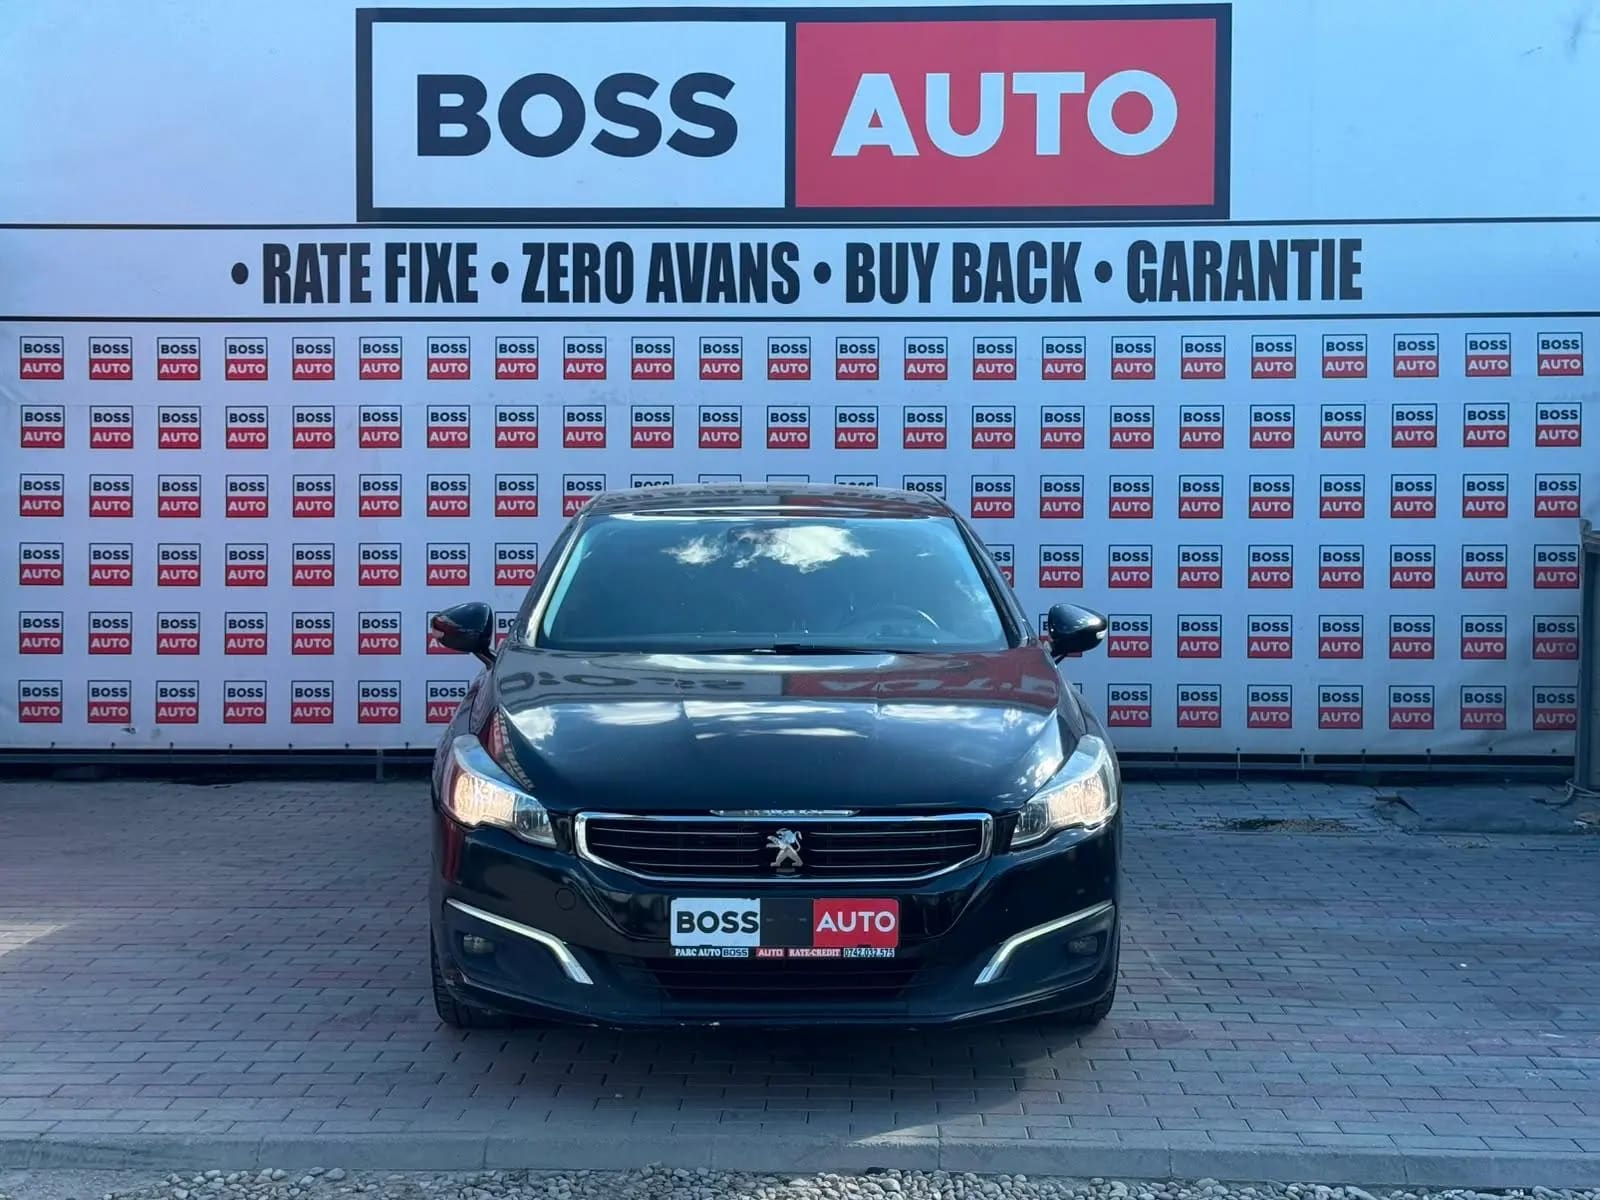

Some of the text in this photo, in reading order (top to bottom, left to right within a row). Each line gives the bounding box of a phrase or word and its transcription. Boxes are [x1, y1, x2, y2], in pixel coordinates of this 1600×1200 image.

[417, 70, 1177, 157] BOSS AUTO
[263, 239, 1362, 304] RATE FIXE ZERO AVANS BUY BACK GARANTIE
[23, 343, 61, 354] BOSS
[160, 344, 197, 355] BOSS
[295, 343, 332, 355] BOSS
[362, 343, 399, 354] BOSS
[498, 343, 536, 354] BOSS
[634, 343, 672, 354] BOSS
[703, 343, 740, 354] BOSS
[839, 343, 876, 354] BOSS
[976, 343, 1014, 354] BOSS
[1045, 343, 1083, 354] BOSS
[1184, 342, 1223, 353] BOSS
[1325, 341, 1364, 352] BOSS
[1397, 340, 1436, 352] BOSS
[1540, 339, 1580, 350] BOSS
[22, 362, 62, 373] AUTO
[159, 363, 199, 374] AUTO
[294, 363, 333, 374] AUTO
[361, 362, 401, 373] AUTO
[497, 362, 537, 373] AUTO
[633, 362, 673, 374] AUTO
[701, 363, 741, 374] AUTO
[838, 363, 877, 374] AUTO
[975, 363, 1015, 374] AUTO
[1044, 362, 1084, 374] AUTO
[1183, 362, 1224, 373] AUTO
[1324, 360, 1365, 372] AUTO
[1395, 360, 1437, 371] AUTO
[1540, 358, 1582, 370] AUTO
[24, 411, 62, 423] BOSS
[161, 412, 198, 424] BOSS
[229, 412, 265, 424] BOSS
[362, 411, 399, 423] BOSS
[498, 411, 535, 423] BOSS
[566, 411, 603, 423] BOSS
[702, 412, 739, 423] BOSS
[838, 412, 876, 424] BOSS
[906, 412, 944, 423] BOSS
[1044, 412, 1082, 423] BOSS
[1183, 411, 1221, 423] BOSS
[1253, 411, 1292, 423] BOSS
[1395, 410, 1434, 422] BOSS
[1539, 409, 1579, 421] BOSS
[22, 431, 63, 442] AUTO
[160, 432, 200, 443] AUTO
[227, 432, 267, 443] AUTO
[361, 431, 400, 442] AUTO
[497, 431, 536, 442] AUTO
[565, 431, 604, 442] AUTO
[700, 431, 740, 442] AUTO
[837, 432, 876, 443] AUTO
[905, 432, 945, 443] AUTO
[1043, 432, 1082, 443] AUTO
[1181, 431, 1222, 442] AUTO
[1252, 431, 1292, 442] AUTO
[1393, 430, 1435, 441] AUTO
[1538, 429, 1579, 441] AUTO
[23, 480, 61, 492] BOSS
[92, 481, 130, 492] BOSS
[229, 481, 266, 492] BOSS
[362, 480, 399, 492] BOSS
[430, 480, 467, 492] BOSS
[566, 480, 603, 491] BOSS
[906, 481, 944, 493] BOSS
[1043, 482, 1081, 493] BOSS
[1112, 482, 1150, 493] BOSS
[1252, 481, 1291, 493] BOSS
[1394, 481, 1433, 492] BOSS
[1466, 480, 1505, 492] BOSS
[21, 499, 62, 511] AUTO
[91, 500, 131, 511] AUTO
[227, 500, 267, 512] AUTO
[361, 500, 400, 511] AUTO
[428, 500, 468, 511] AUTO
[565, 500, 588, 512] AU
[1041, 501, 1082, 512] AUTO
[1111, 501, 1151, 512] AUTO
[1251, 501, 1292, 512] AUTO
[1392, 500, 1434, 512] AUTO
[1464, 500, 1506, 512] AUTO
[92, 549, 130, 561] BOSS
[228, 550, 265, 561] BOSS
[295, 550, 332, 561] BOSS
[430, 549, 467, 560] BOSS
[1111, 551, 1149, 562] BOSS
[1251, 551, 1290, 563] BOSS
[1322, 551, 1361, 563] BOSS
[1465, 551, 1505, 562] BOSS
[91, 569, 131, 580] AUTO
[227, 569, 266, 580] AUTO
[294, 569, 333, 580] AUTO
[428, 568, 468, 580] AUTO
[1110, 571, 1150, 582] AUTO
[1250, 571, 1291, 582] AUTO
[1321, 571, 1362, 582] AUTO
[1463, 571, 1505, 582] AUTO
[92, 618, 129, 629] BOSS
[160, 618, 197, 629] BOSS
[295, 618, 331, 629] BOSS
[1111, 621, 1149, 632] BOSS
[1180, 621, 1219, 632] BOSS
[1322, 622, 1360, 633] BOSS
[1464, 622, 1504, 633] BOSS
[1536, 622, 1576, 634] BOSS
[90, 637, 130, 649] AUTO
[159, 638, 198, 649] AUTO
[293, 638, 333, 649] AUTO
[1110, 640, 1150, 652] AUTO
[1179, 640, 1220, 652] AUTO
[1320, 641, 1361, 653] AUTO
[1463, 641, 1505, 653] AUTO
[1535, 642, 1577, 654] AUTO
[22, 686, 60, 698] BOSS
[159, 687, 196, 698] BOSS
[294, 687, 331, 698] BOSS
[361, 687, 398, 698] BOSS
[429, 687, 466, 698] BOSS
[1180, 691, 1218, 702] BOSS
[1321, 692, 1360, 703] BOSS
[1392, 692, 1431, 704] BOSS
[1536, 693, 1576, 704] BOSS
[21, 706, 61, 717] AUTO
[157, 706, 197, 718] AUTO
[293, 706, 332, 718] AUTO
[360, 706, 399, 717] AUTO
[428, 706, 457, 717] AUT
[1179, 710, 1219, 721] AUTO
[1320, 711, 1361, 723] AUTO
[1391, 712, 1432, 723] AUTO
[1535, 712, 1576, 724] AUTO
[676, 911, 760, 934] BOSS
[816, 911, 896, 933] AUTO
[675, 948, 748, 957] PARC AUTO BOSS
